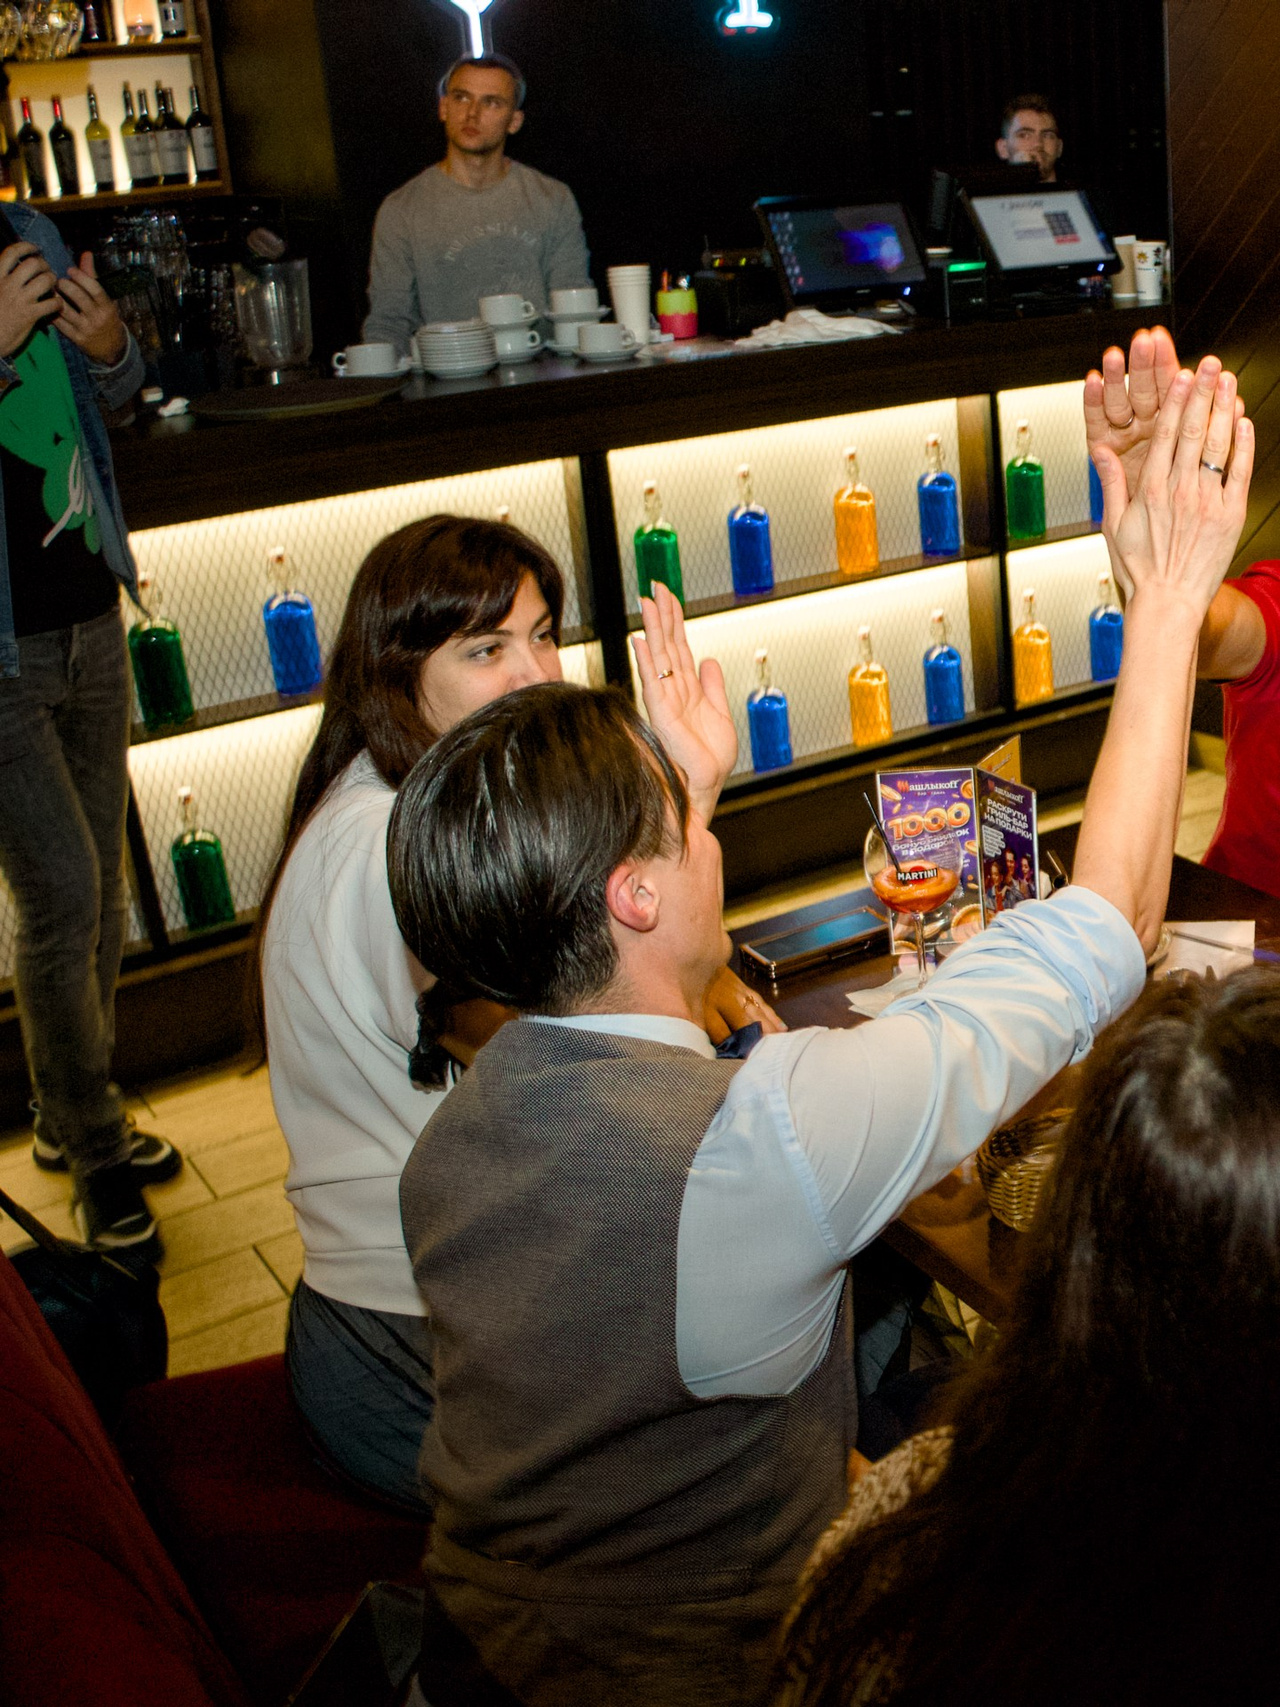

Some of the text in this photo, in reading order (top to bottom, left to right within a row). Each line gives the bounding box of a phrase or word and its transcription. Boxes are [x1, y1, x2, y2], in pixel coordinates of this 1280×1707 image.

[888, 802, 971, 841] 1000
[987, 799, 1027, 822] РАСКРУТИ
[985, 813, 1033, 840] НА ПОДАРКИ
[897, 868, 938, 881] MARTINI
